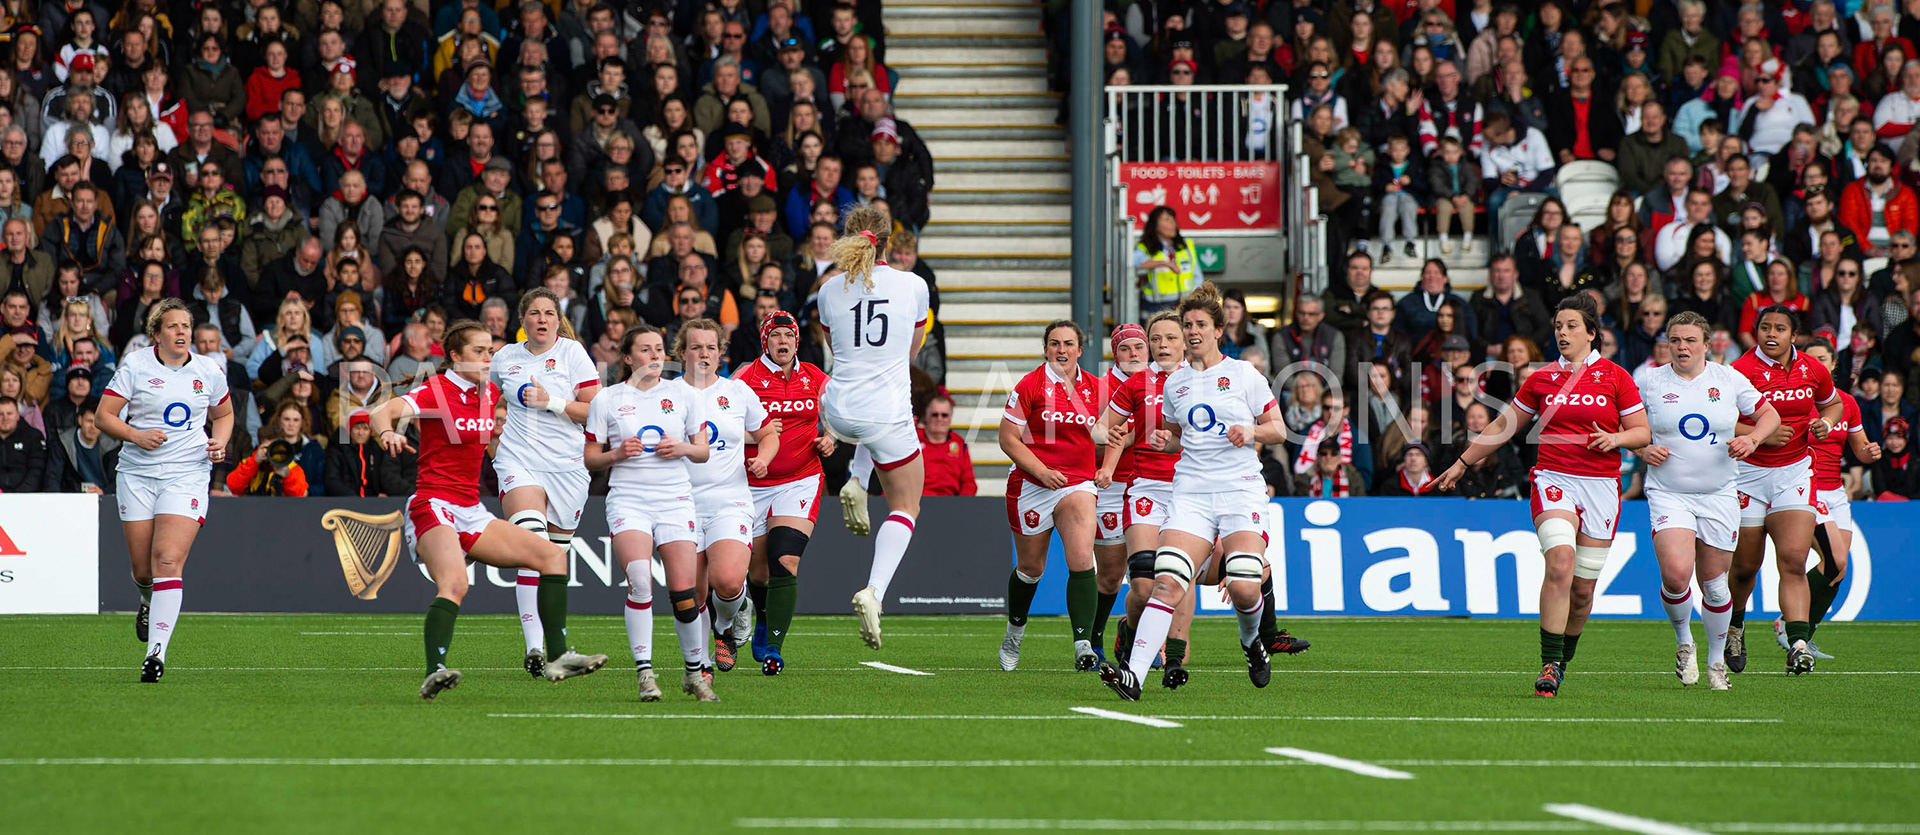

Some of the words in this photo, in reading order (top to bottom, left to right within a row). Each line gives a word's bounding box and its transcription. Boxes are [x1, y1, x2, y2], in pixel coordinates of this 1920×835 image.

[1131, 167, 1167, 179] FOOD
[1176, 167, 1225, 179] TOILETS
[1233, 167, 1265, 179] BARS
[850, 299, 889, 347] 15
[1545, 394, 1607, 407] CAZOO
[1041, 410, 1096, 426] CAZOO
[1188, 403, 1227, 436] O2
[1678, 413, 1718, 445] O2
